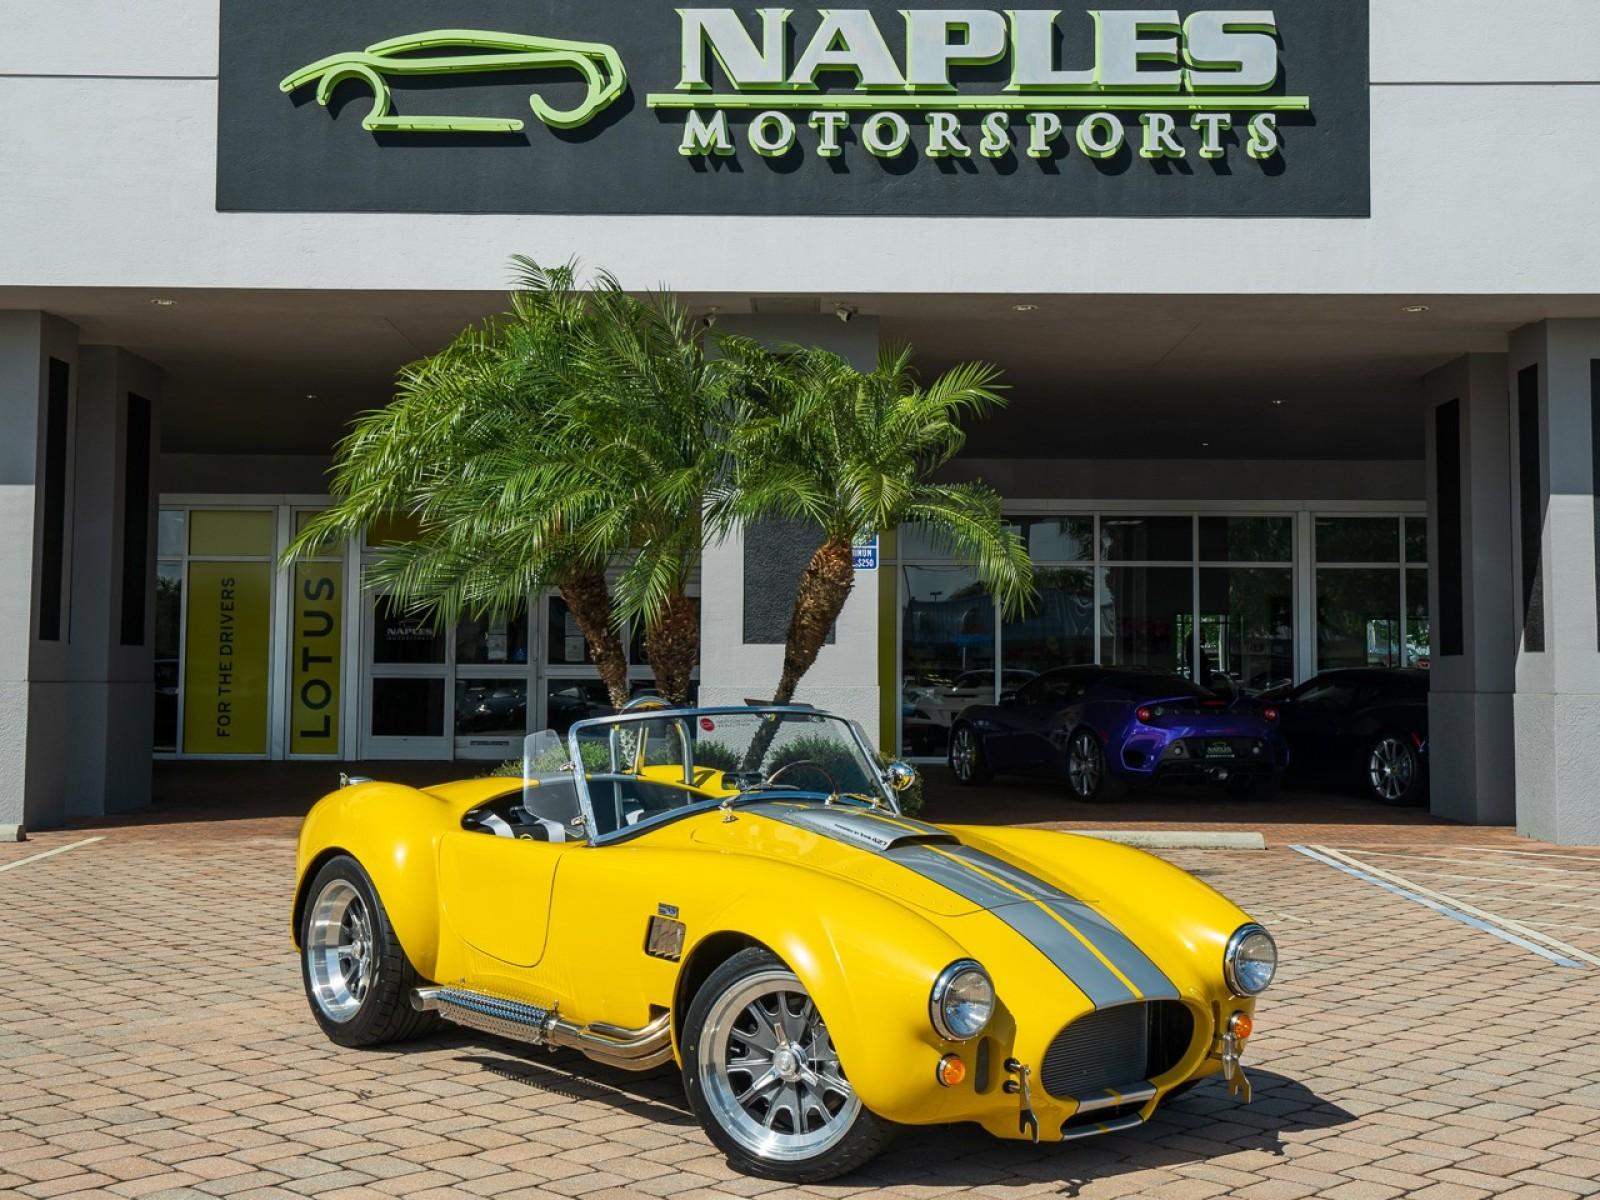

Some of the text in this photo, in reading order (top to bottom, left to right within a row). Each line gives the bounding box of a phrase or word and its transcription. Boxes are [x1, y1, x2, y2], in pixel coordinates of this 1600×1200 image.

[676, 8, 1277, 91] NAPLES
[678, 110, 1279, 158] MOTORSPORTS
[217, 577, 235, 736] FOR THE DRIVERS
[300, 577, 334, 738] LOTUS
